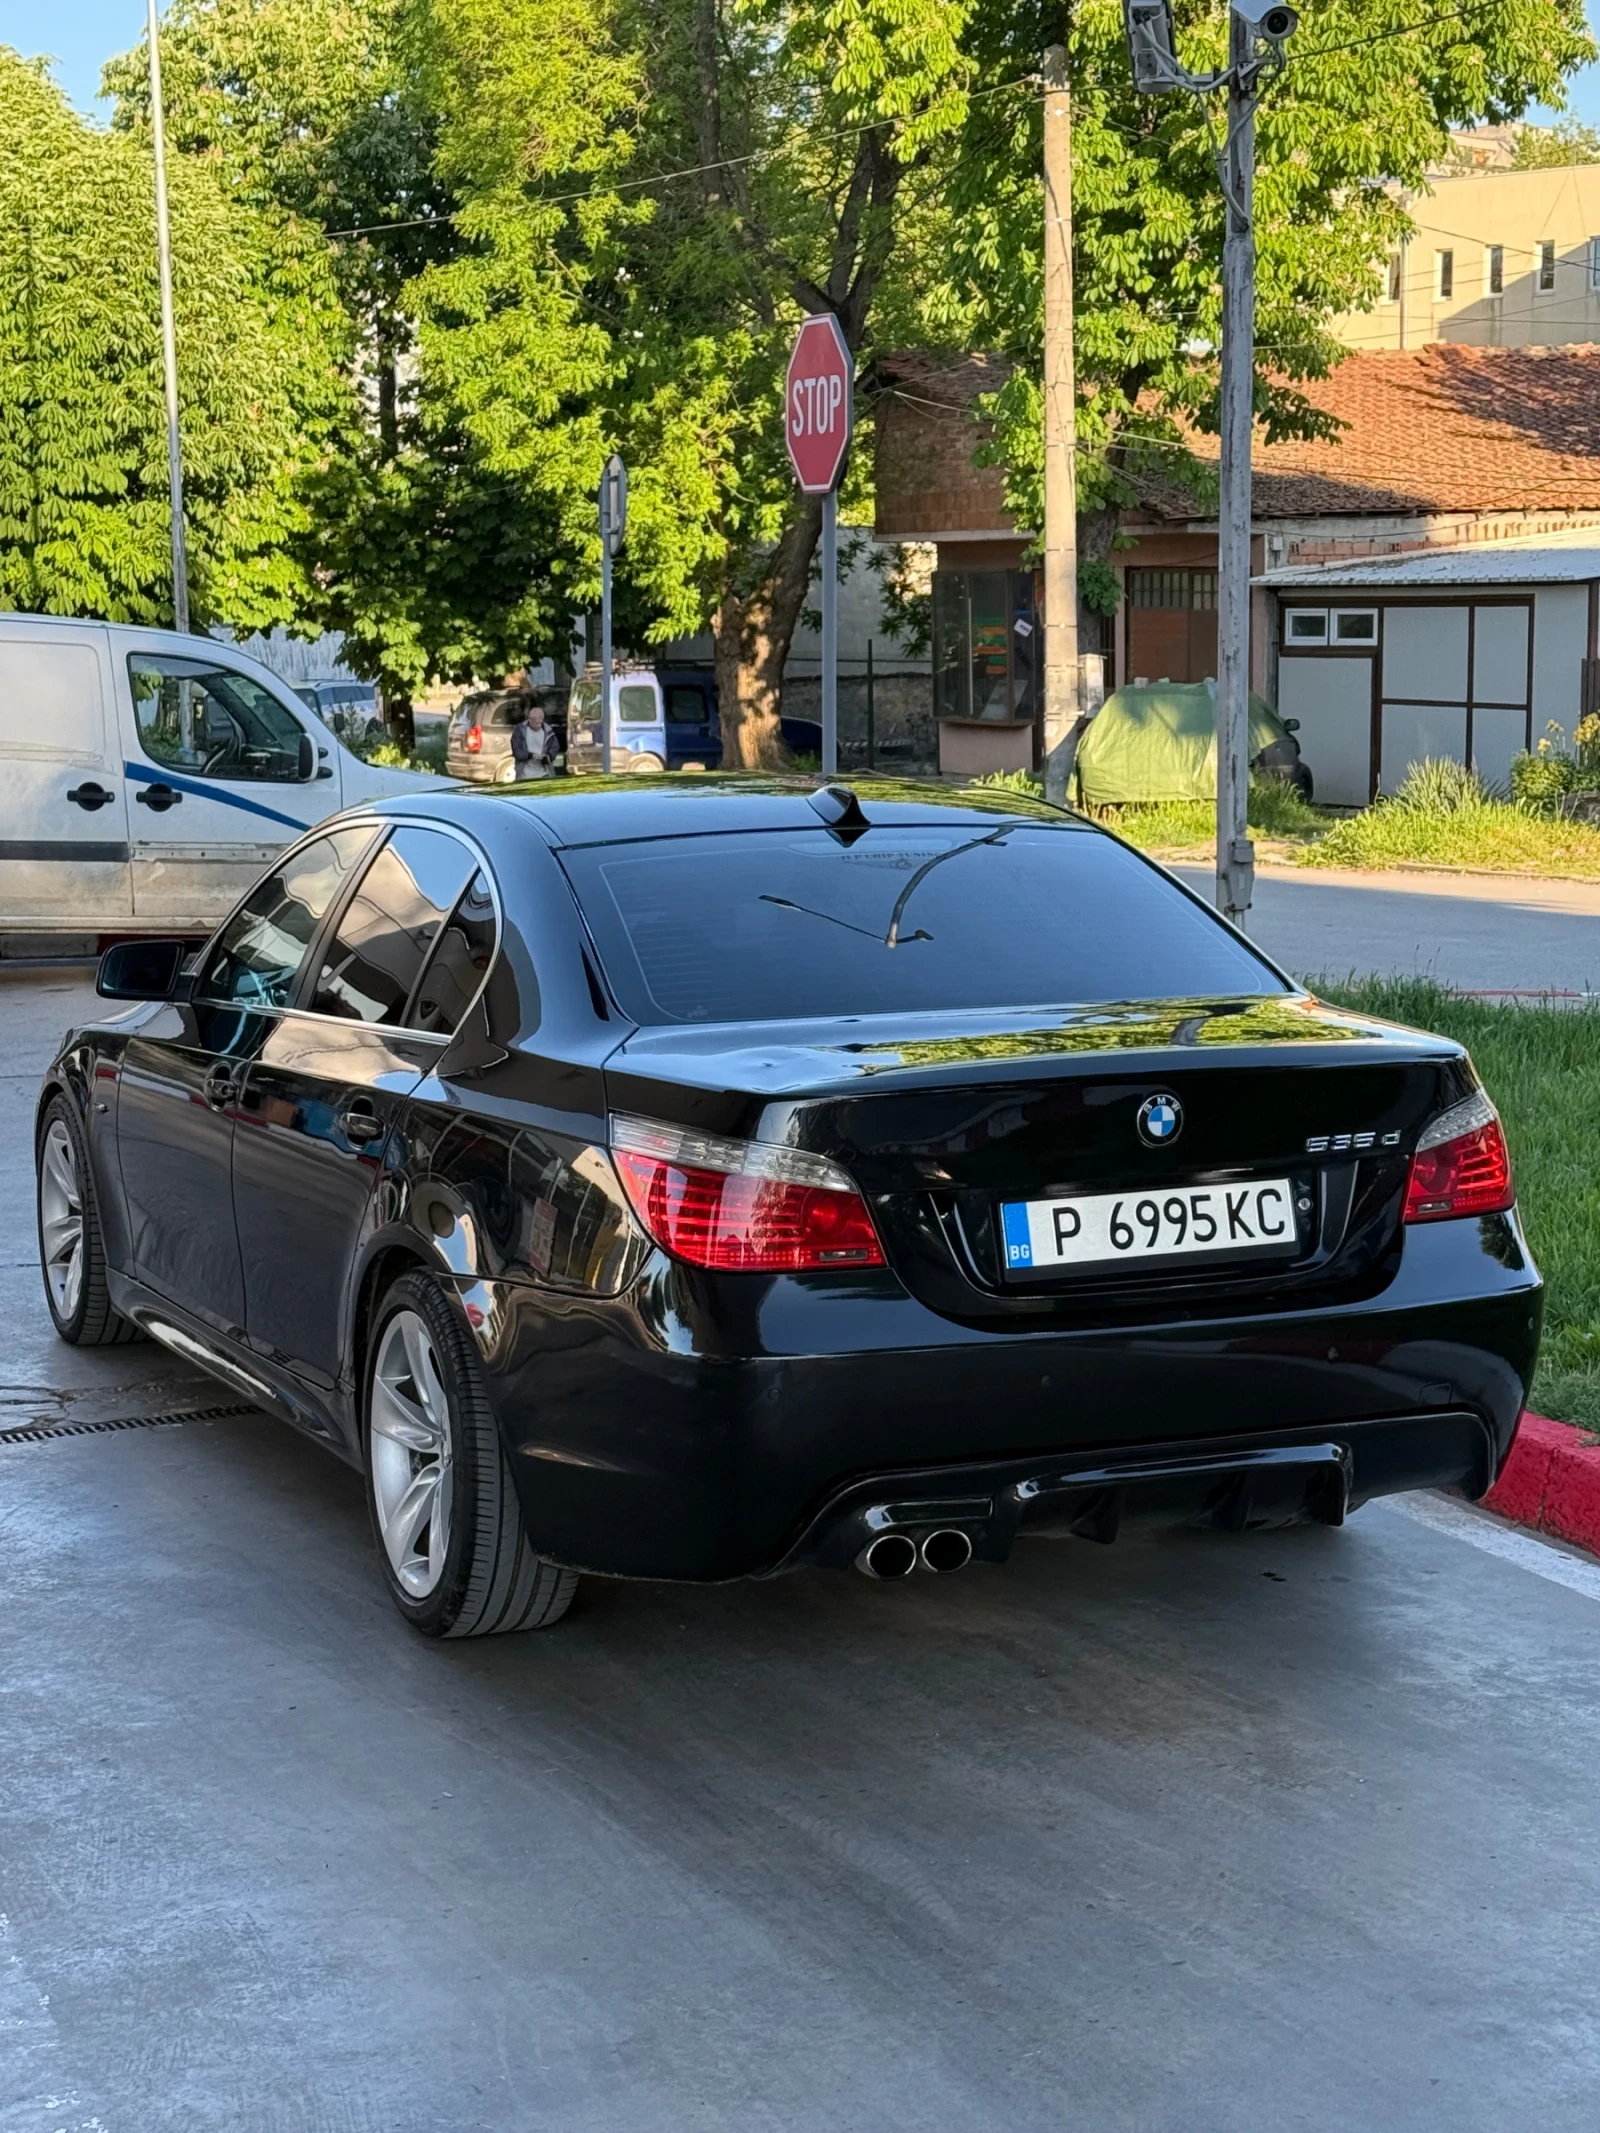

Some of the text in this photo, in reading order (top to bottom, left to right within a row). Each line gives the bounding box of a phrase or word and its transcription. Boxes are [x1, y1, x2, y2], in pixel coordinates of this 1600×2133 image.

[792, 374, 842, 437] STOP
[1143, 1096, 1181, 1114] BMW
[1010, 1244, 1030, 1261] BG
